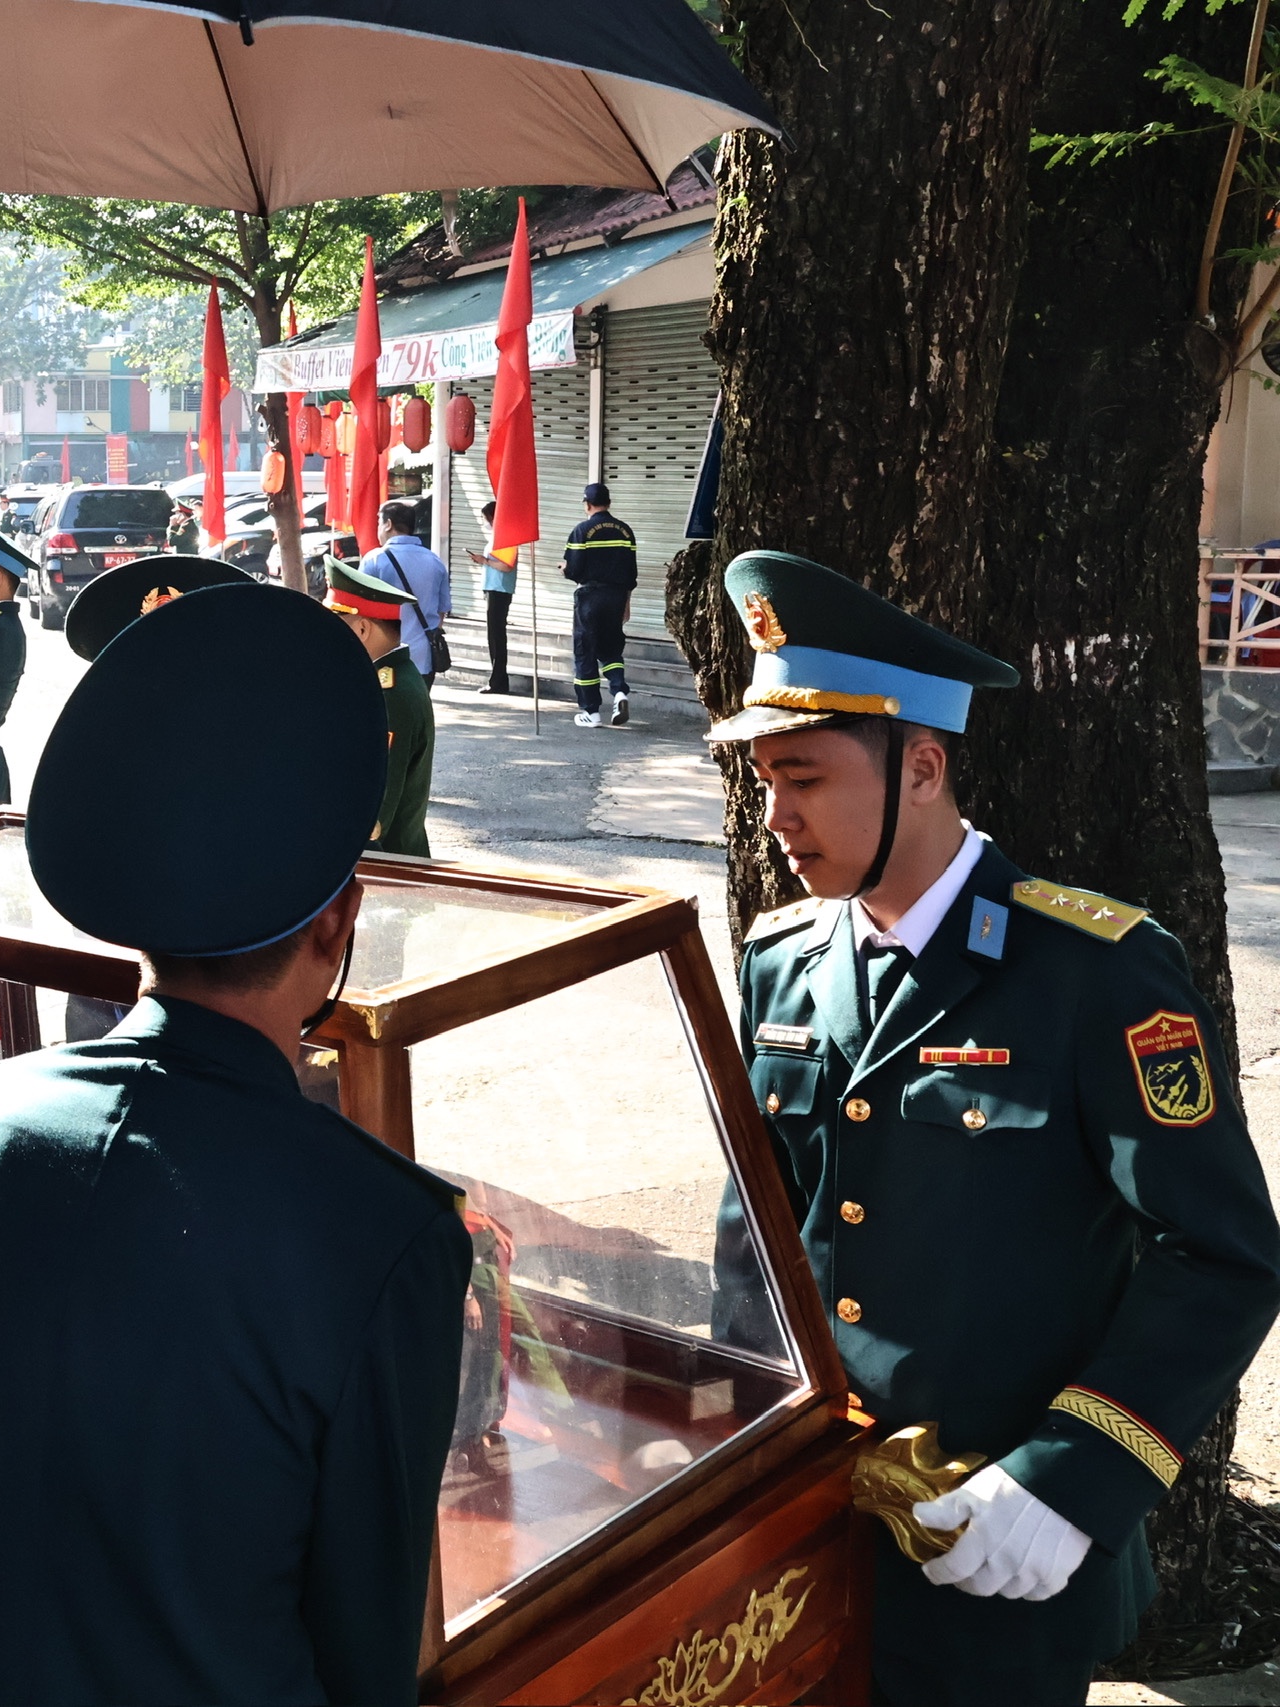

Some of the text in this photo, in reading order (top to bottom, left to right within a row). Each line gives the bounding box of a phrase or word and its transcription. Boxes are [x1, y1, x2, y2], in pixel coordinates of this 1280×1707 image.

[293, 351, 325, 388] Buffet
[391, 338, 440, 381] 79k
[441, 335, 468, 374] Công
